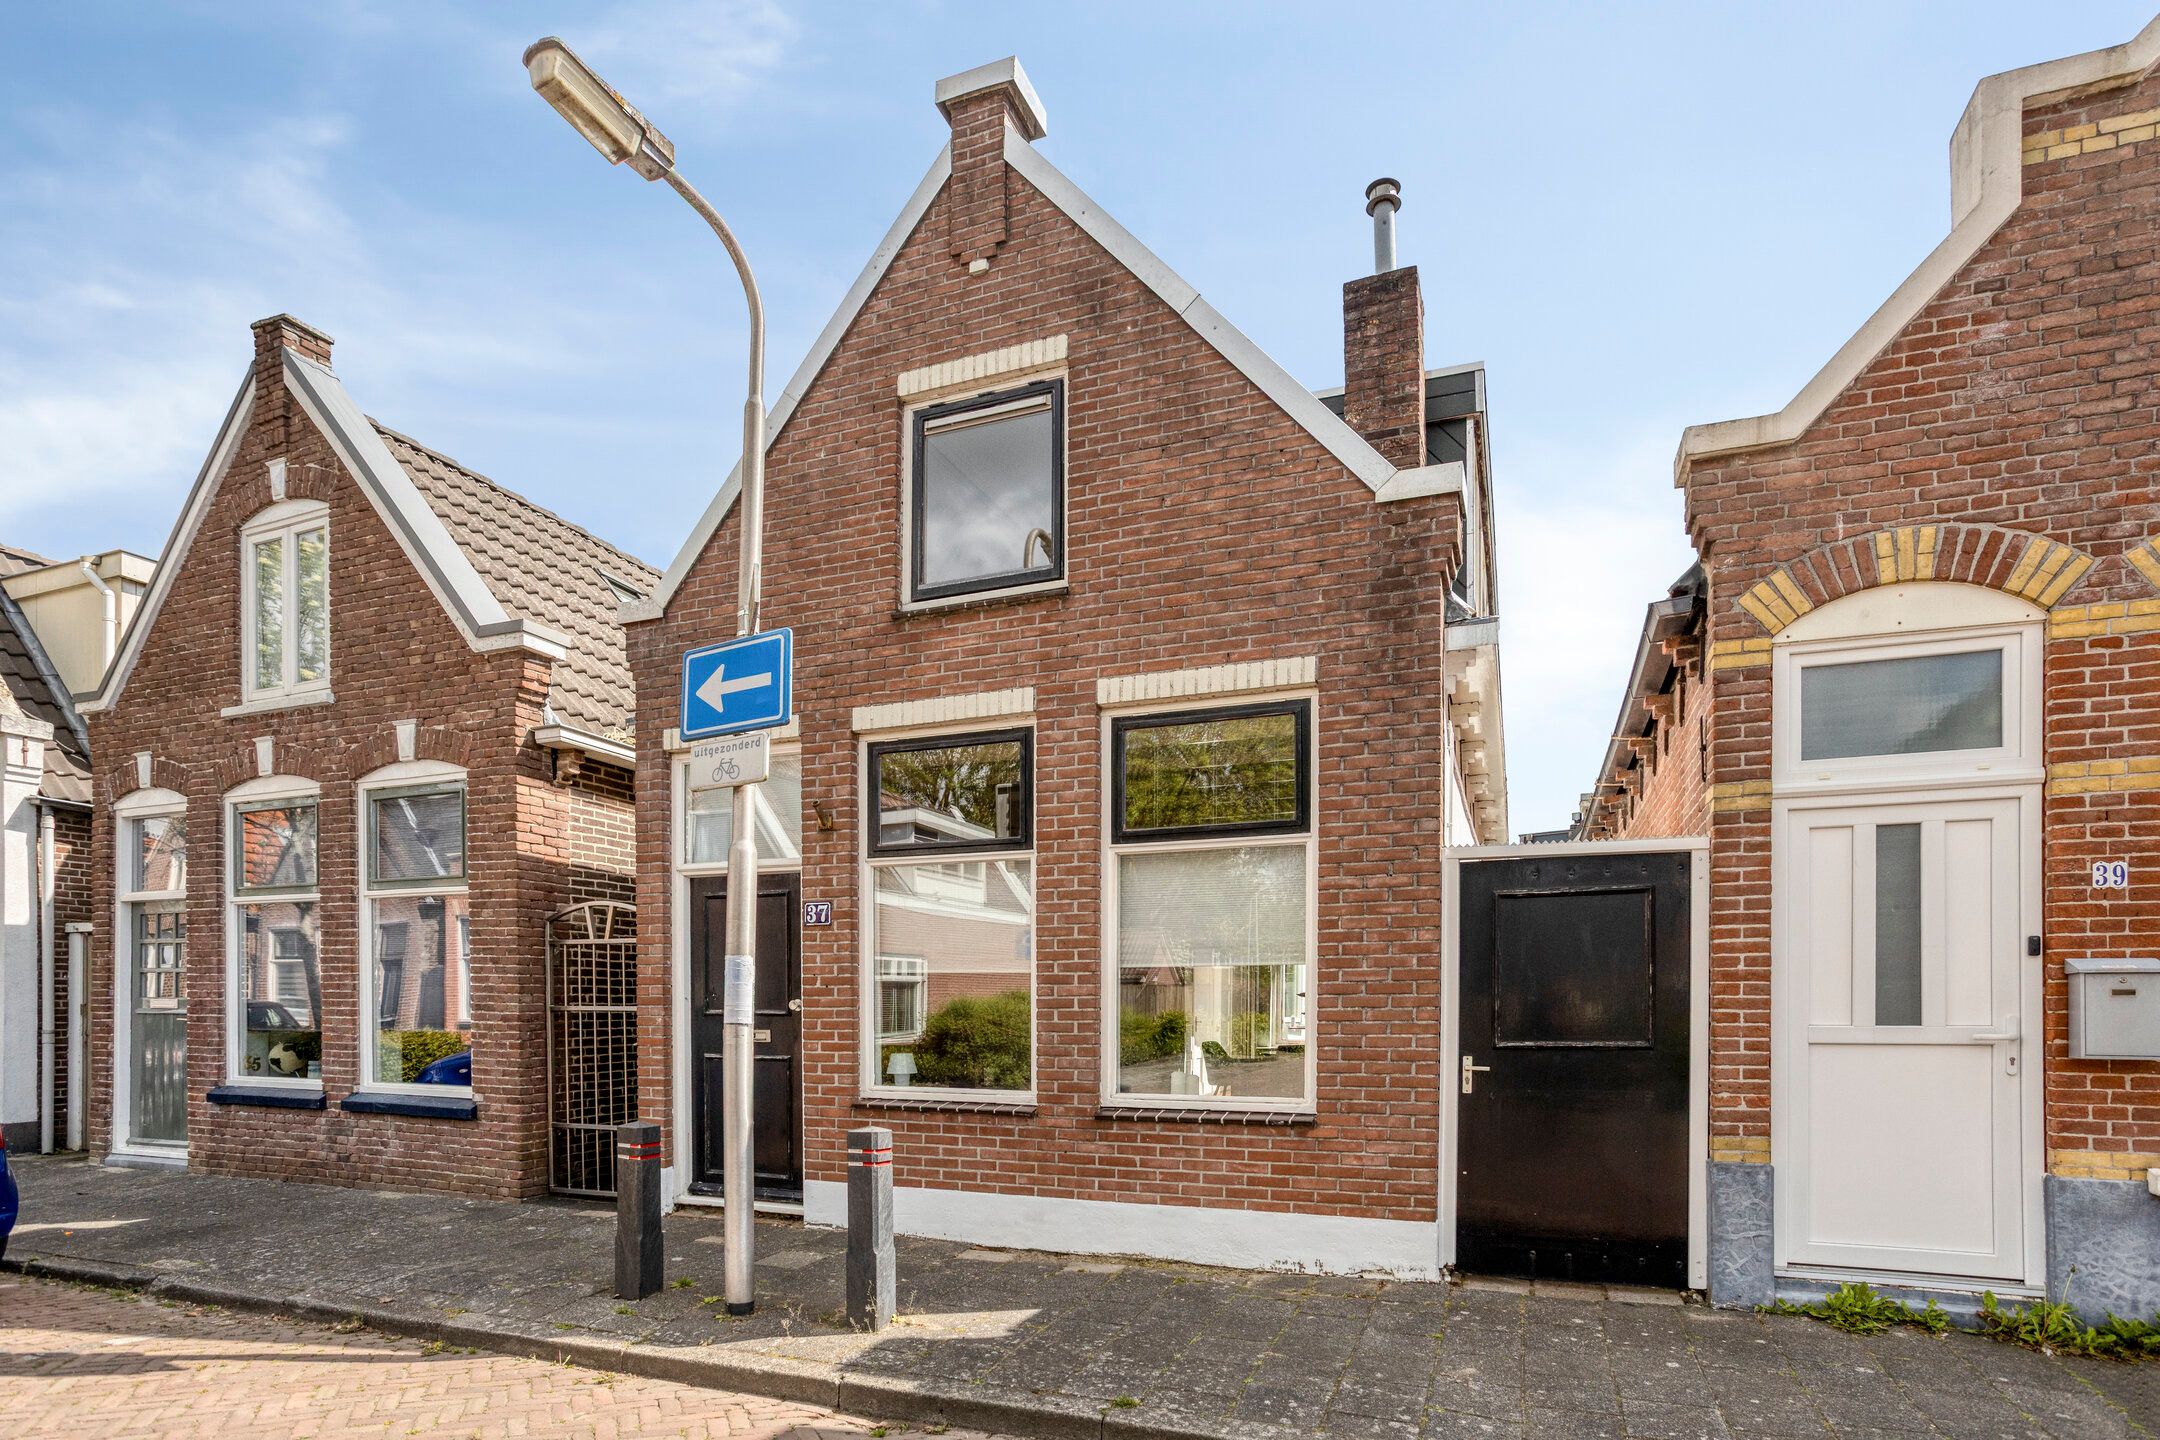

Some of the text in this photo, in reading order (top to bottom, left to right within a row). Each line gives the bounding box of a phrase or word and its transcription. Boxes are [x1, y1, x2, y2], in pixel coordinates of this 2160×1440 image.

[694, 736, 761, 758] uitgezonderd
[2095, 864, 2126, 887] 39
[806, 904, 828, 923] 37
